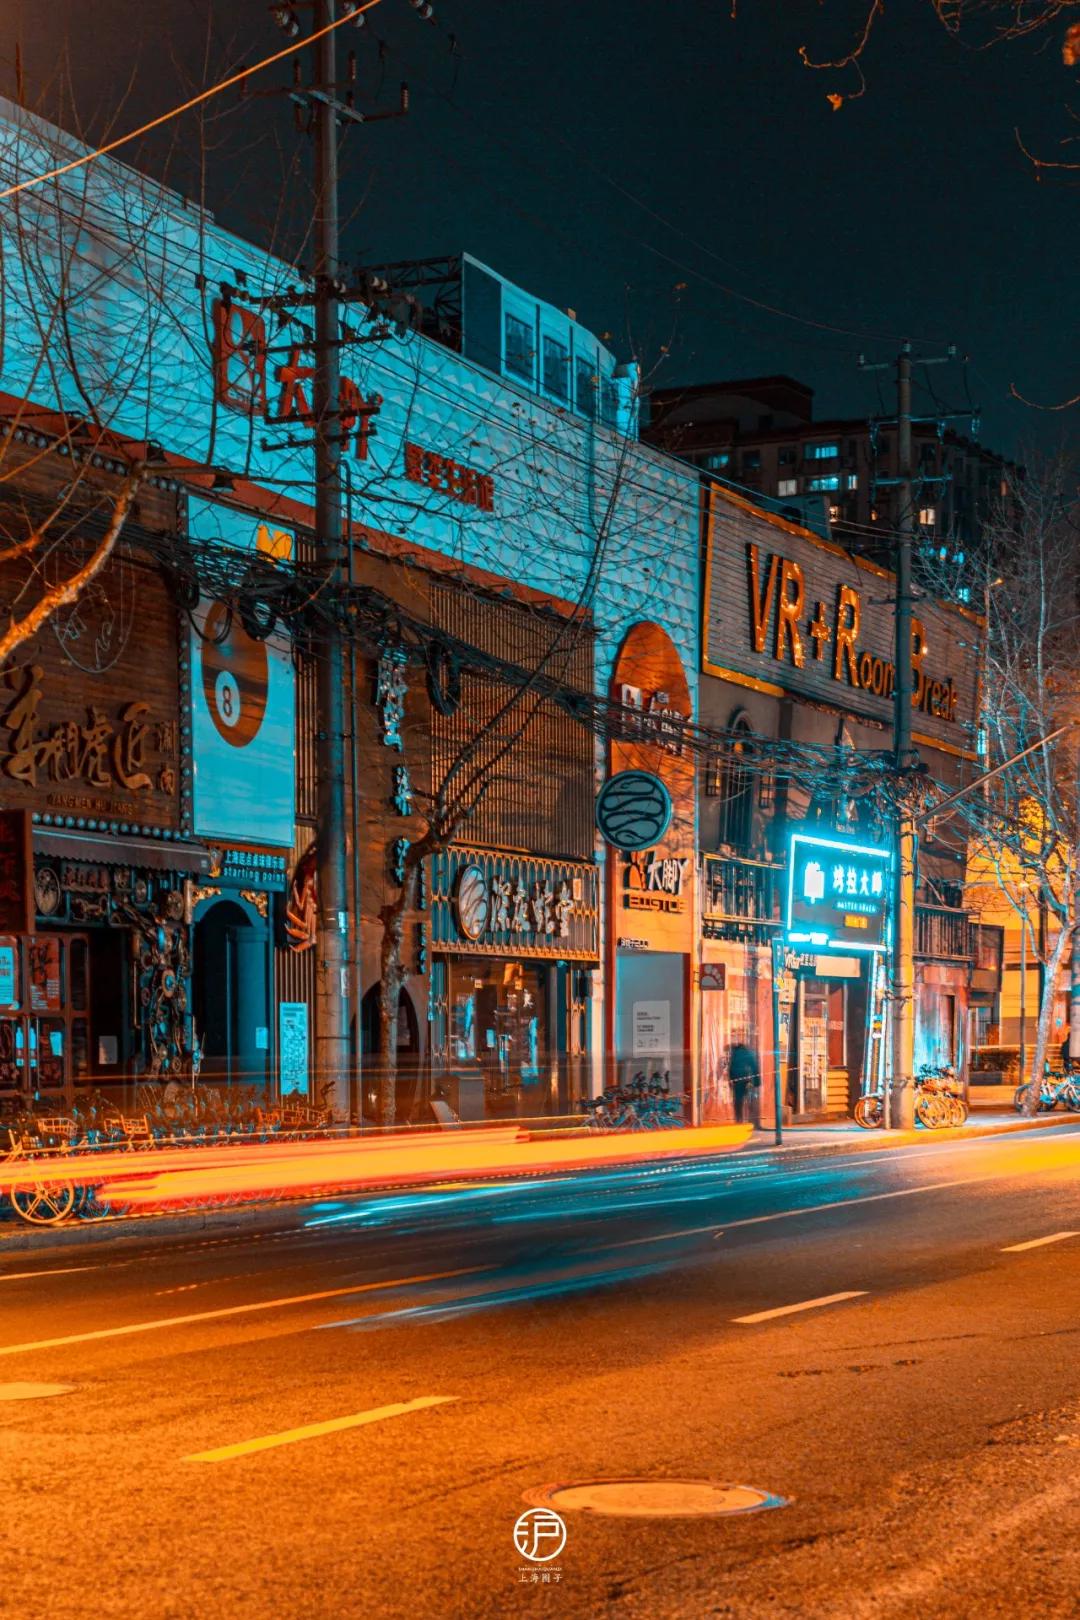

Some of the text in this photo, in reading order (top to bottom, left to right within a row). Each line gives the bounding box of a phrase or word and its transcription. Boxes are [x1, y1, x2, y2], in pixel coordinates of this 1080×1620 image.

[222, 686, 233, 718] 8
[223, 866, 285, 882] starting point
